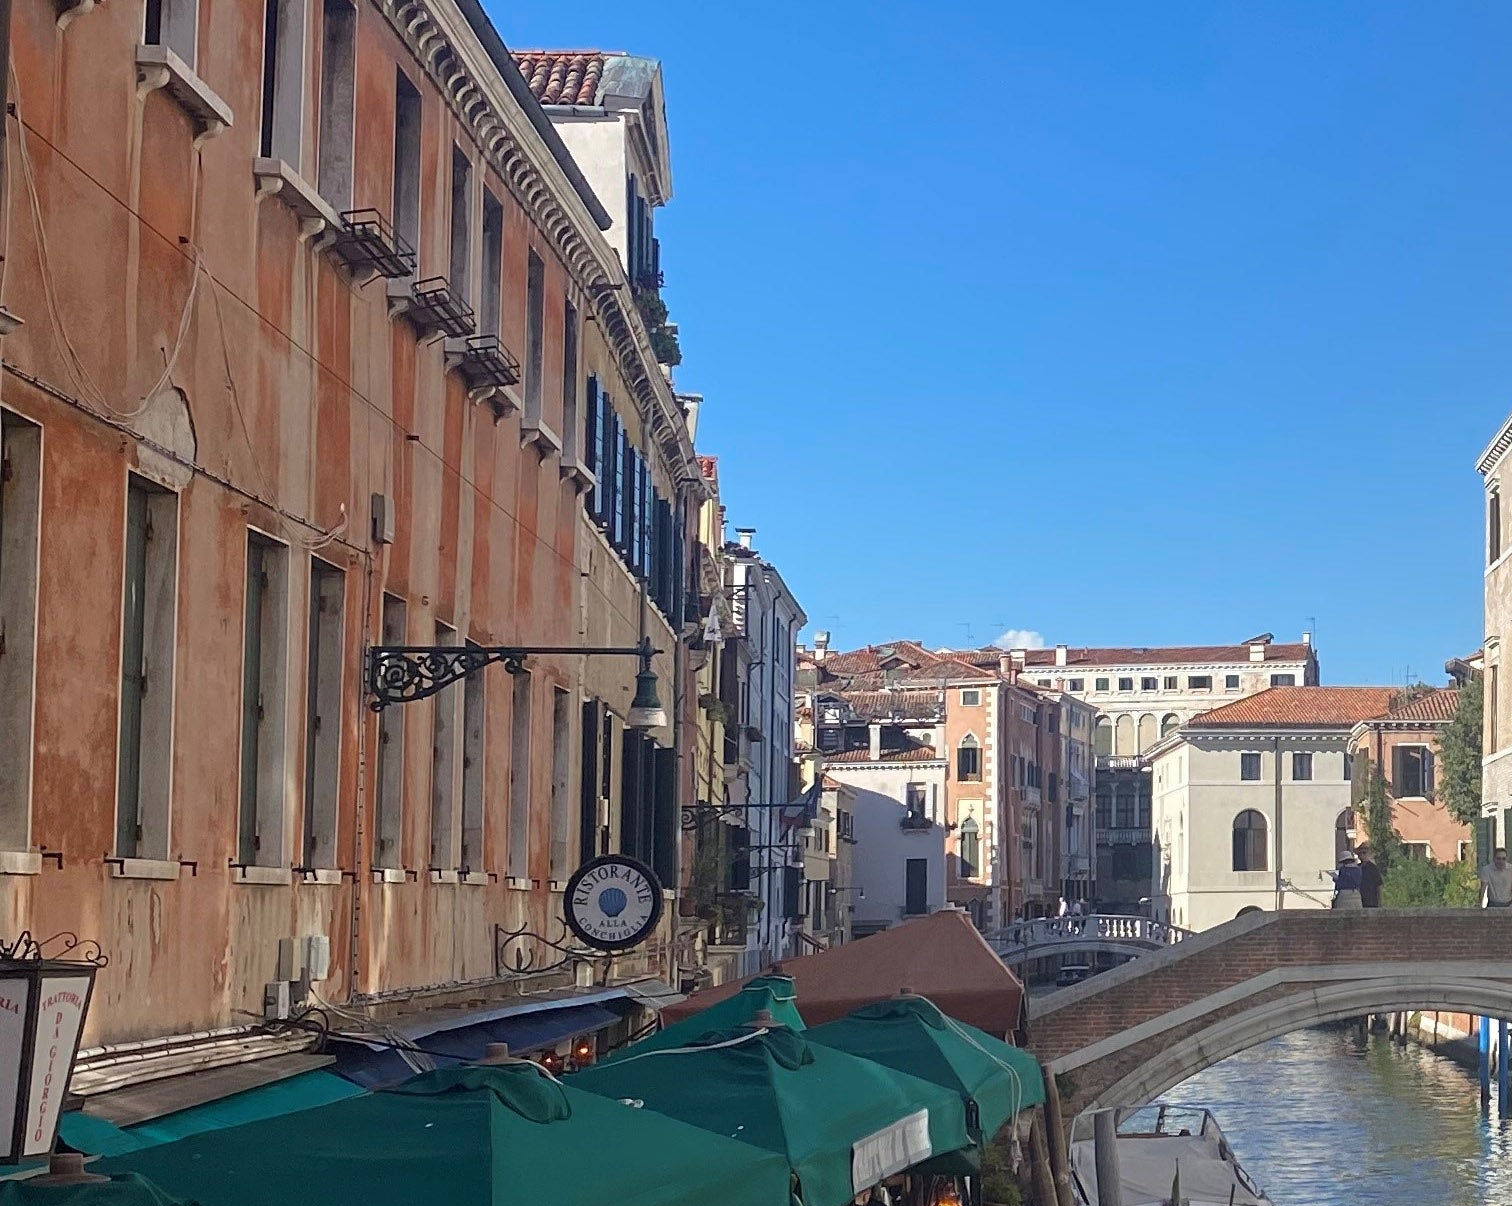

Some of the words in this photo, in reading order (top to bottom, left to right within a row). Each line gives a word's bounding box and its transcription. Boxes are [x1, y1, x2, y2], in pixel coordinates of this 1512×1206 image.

[573, 864, 653, 907] RISTORANTE
[578, 915, 649, 941] CONCHIGLIA
[599, 919, 628, 928] ALLA
[42, 991, 82, 1011] TRATTORIA
[34, 1045, 57, 1142] GIORGIO
